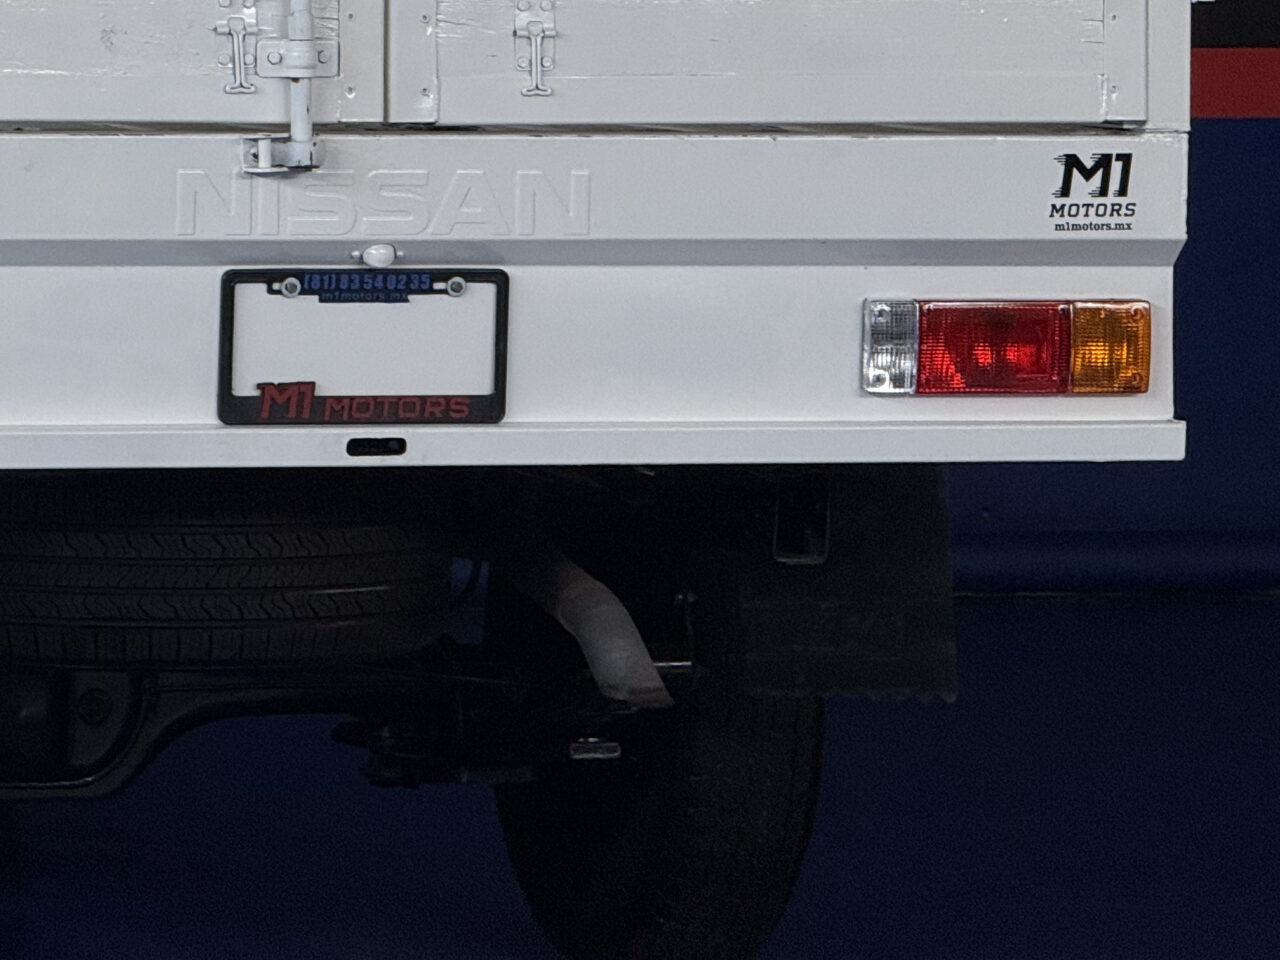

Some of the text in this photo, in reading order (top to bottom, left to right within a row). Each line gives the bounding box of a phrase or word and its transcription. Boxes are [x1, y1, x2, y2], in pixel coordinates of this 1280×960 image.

[1051, 152, 1133, 199] M1
[176, 168, 591, 236] NISSAN
[1049, 202, 1137, 218] MOTORS
[1054, 221, 1133, 232] m1motors.mx
[259, 382, 472, 421] M1 MOTORS
